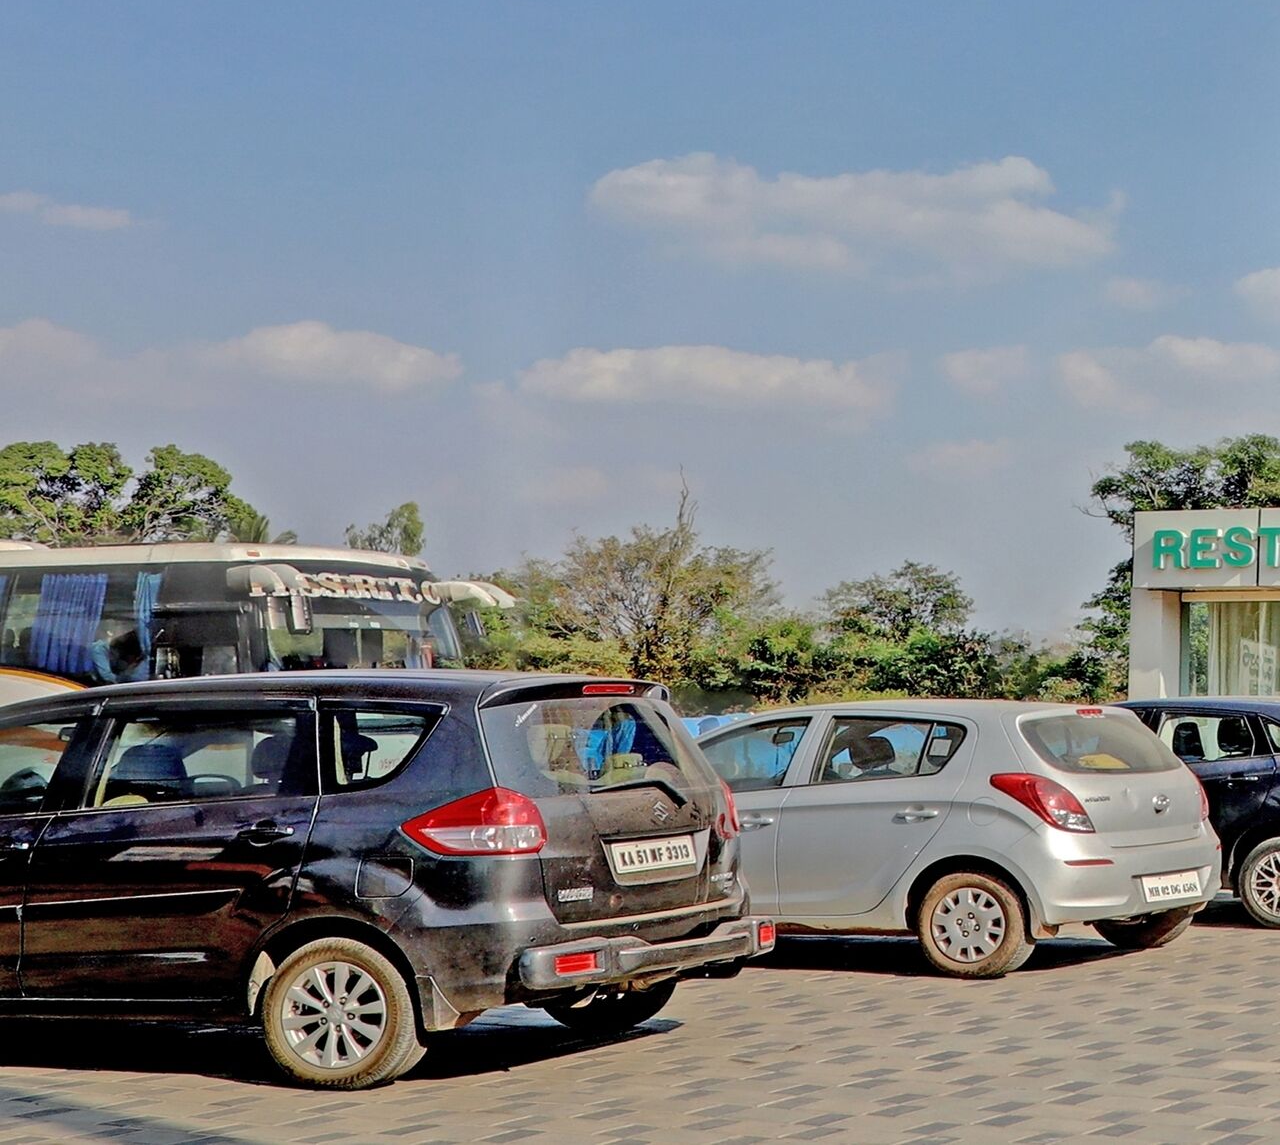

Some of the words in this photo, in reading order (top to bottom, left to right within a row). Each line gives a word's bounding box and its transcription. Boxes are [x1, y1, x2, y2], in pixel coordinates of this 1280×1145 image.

[620, 851, 635, 866] KA
[637, 849, 648, 864] 51
[666, 844, 690, 860] 3313
